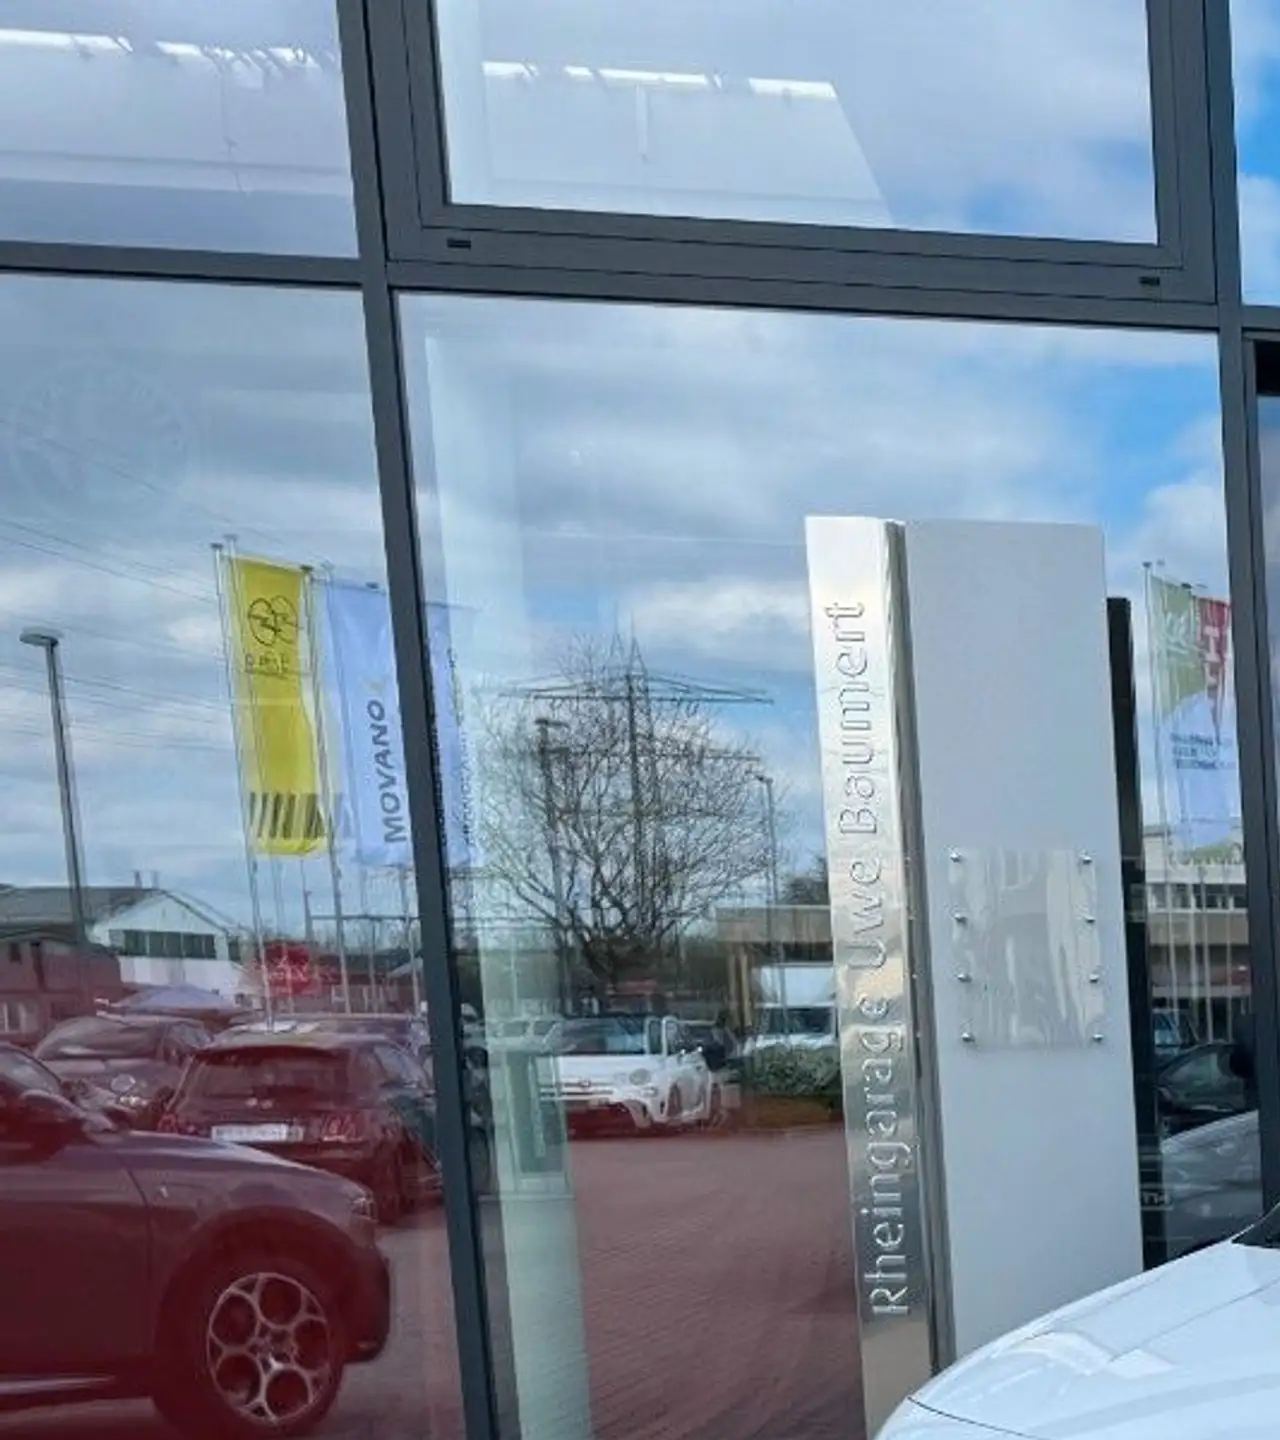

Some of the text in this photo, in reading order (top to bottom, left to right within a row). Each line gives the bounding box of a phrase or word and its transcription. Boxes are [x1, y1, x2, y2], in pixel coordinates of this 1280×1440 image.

[367, 699, 408, 844] MOVANO
[825, 601, 912, 1315] Rheingarage Uwe Baumert
